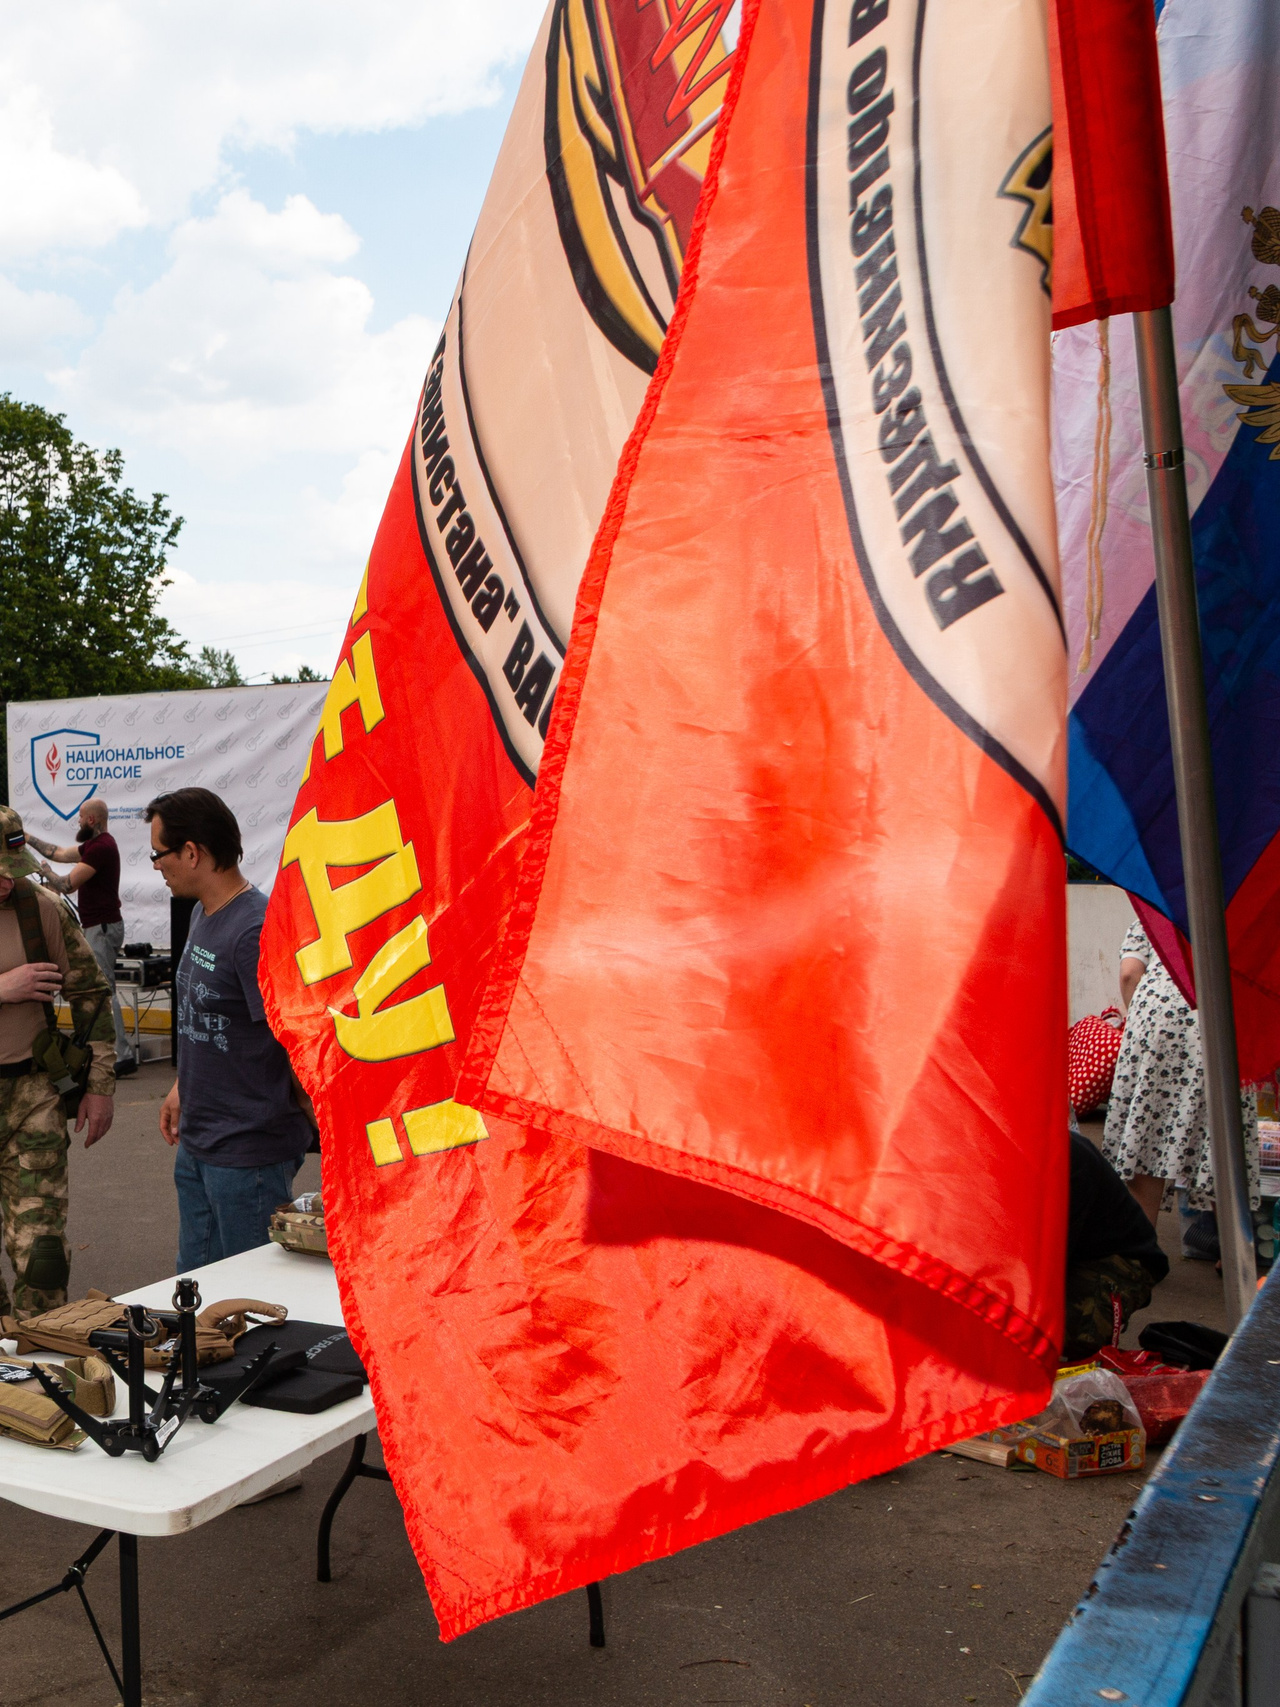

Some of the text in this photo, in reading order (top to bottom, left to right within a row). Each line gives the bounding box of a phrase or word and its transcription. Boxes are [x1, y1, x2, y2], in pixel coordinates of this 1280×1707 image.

[66, 745, 185, 765] НАЦИОНАЛЬНОЕ
[66, 765, 142, 781] СОГЛАСИЕ
[282, 560, 490, 1167] ЕДУ!
